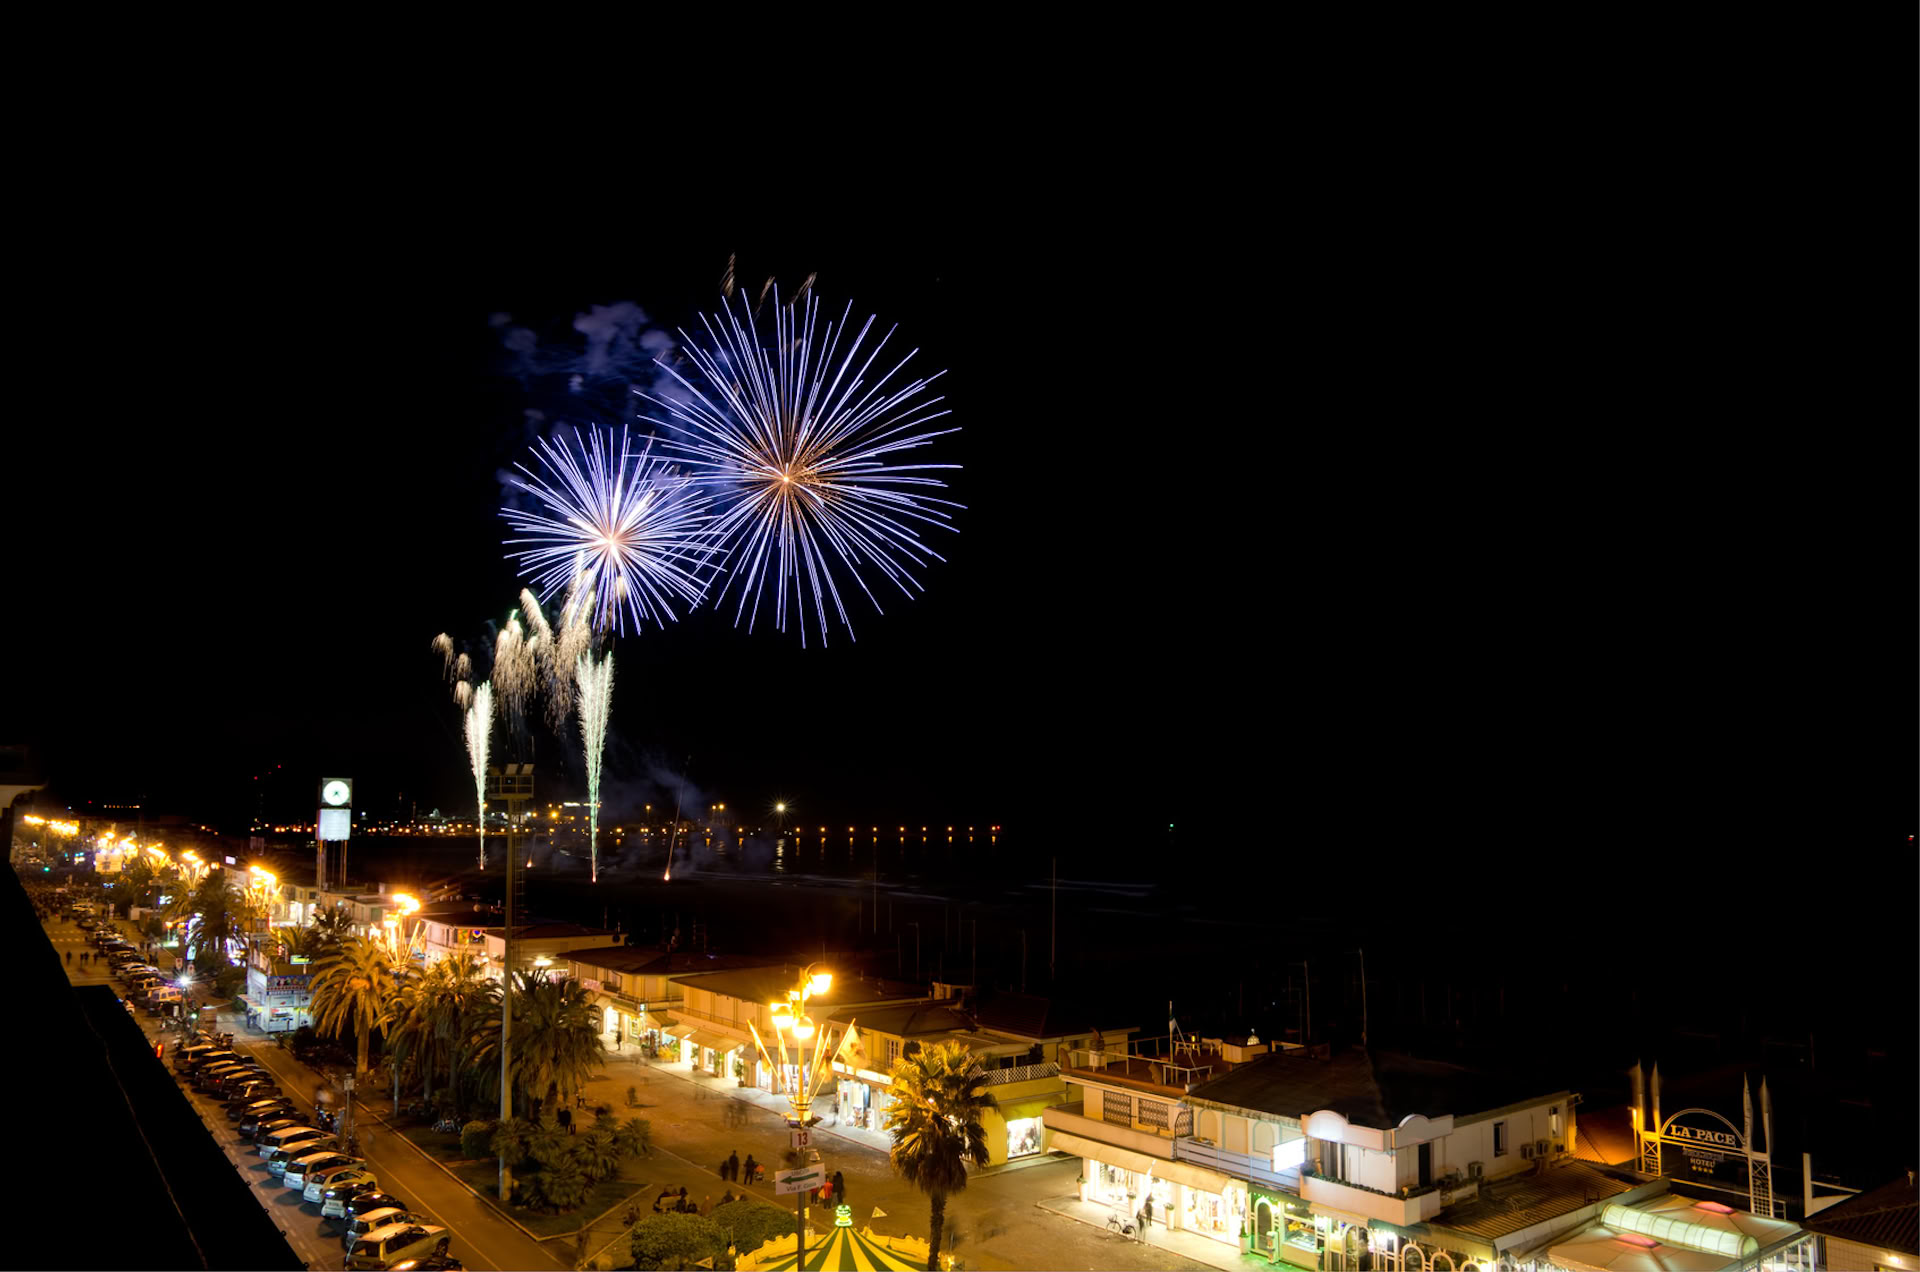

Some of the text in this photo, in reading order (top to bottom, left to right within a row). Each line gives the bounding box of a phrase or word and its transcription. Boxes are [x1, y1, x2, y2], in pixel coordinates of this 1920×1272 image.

[797, 1132, 808, 1146] 13
[1670, 1124, 1736, 1145] LA PACE
